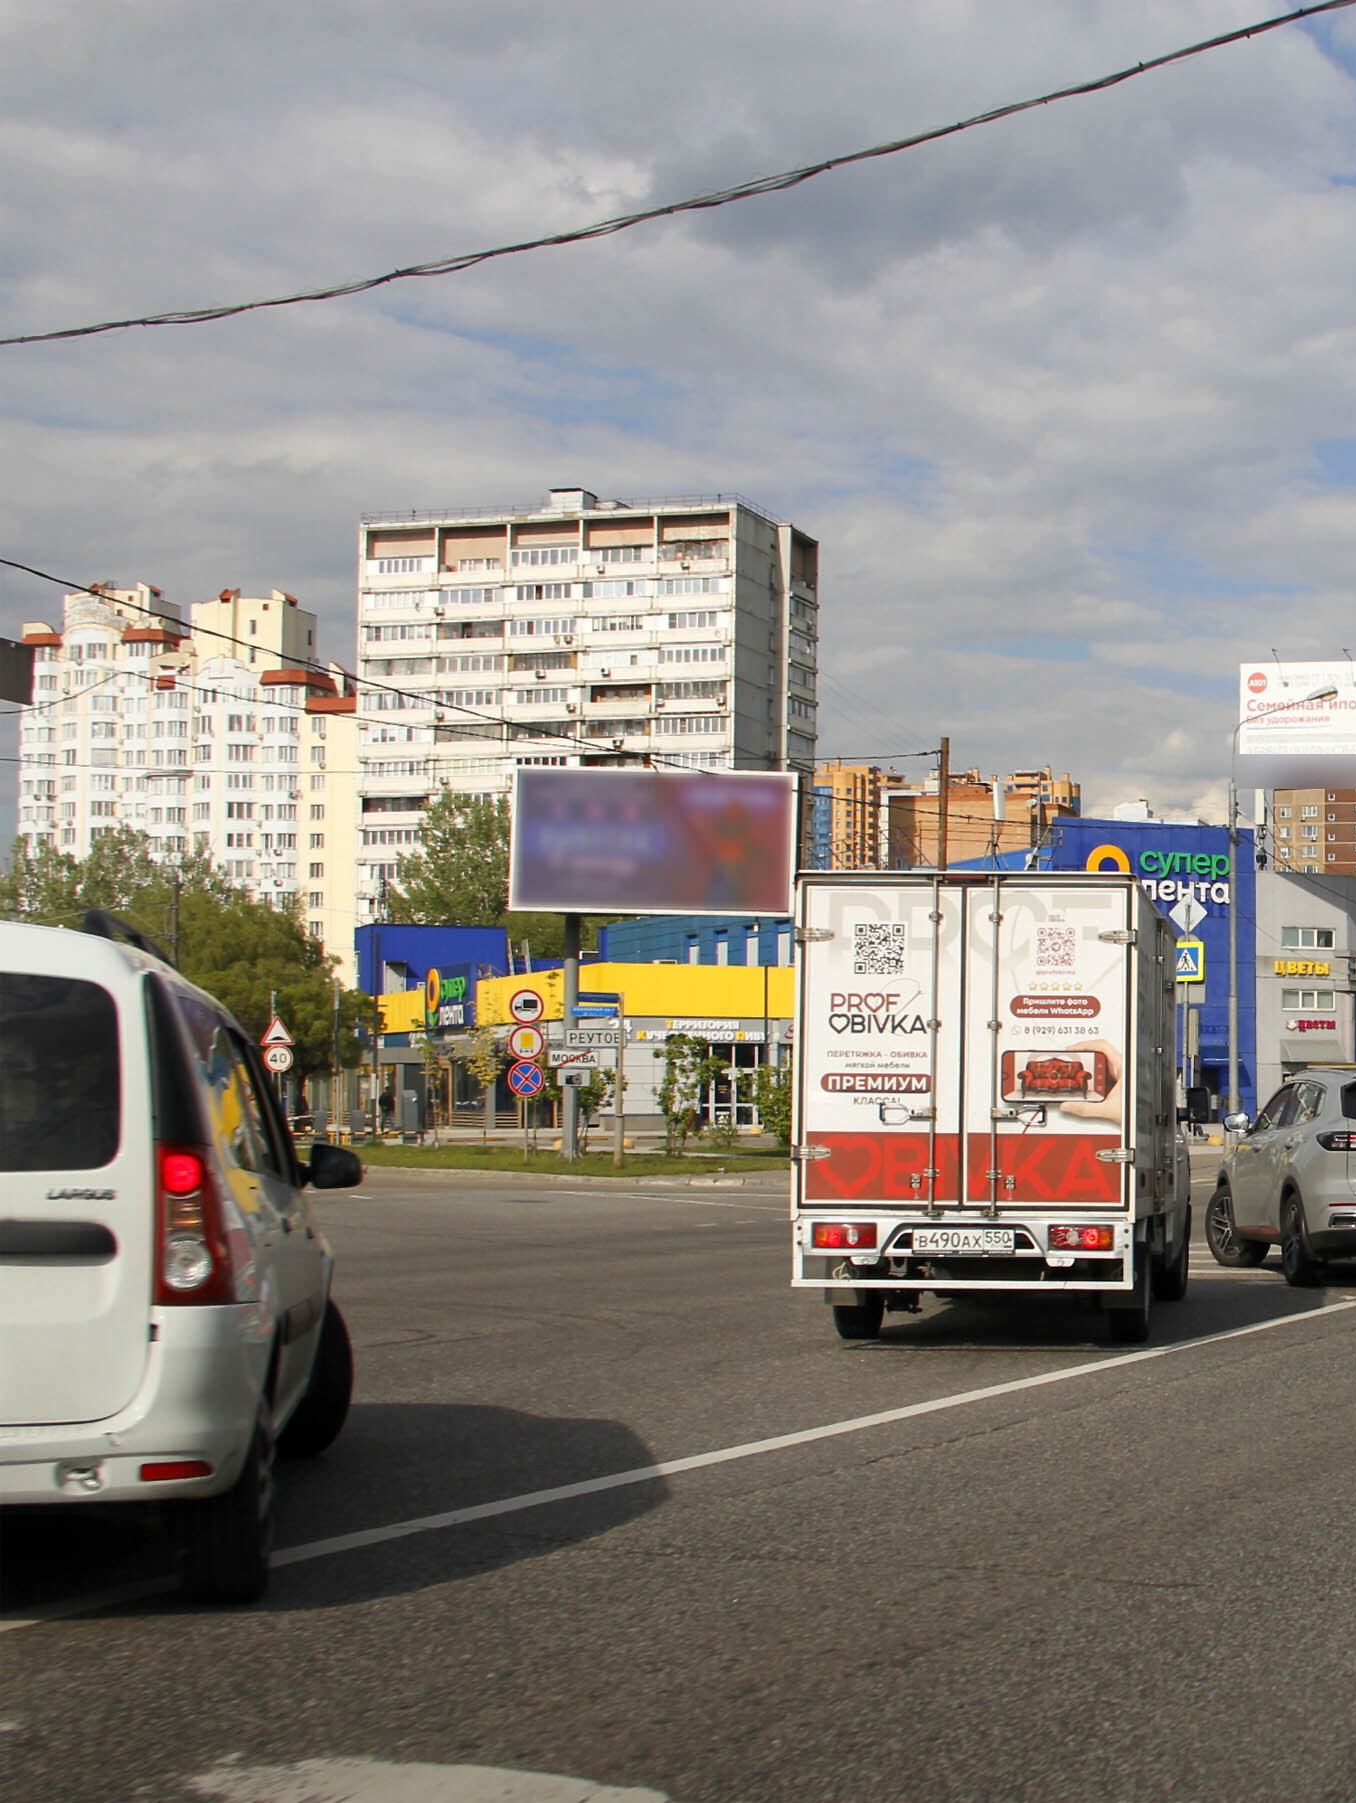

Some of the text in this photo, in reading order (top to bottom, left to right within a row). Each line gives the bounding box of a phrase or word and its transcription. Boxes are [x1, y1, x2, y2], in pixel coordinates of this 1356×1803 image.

[1247, 698, 1323, 711] Семейная
[1140, 850, 1231, 880] супер
[1141, 879, 1230, 904] лента
[1274, 960, 1331, 976] ЦВЕТЫ
[1023, 997, 1088, 1006] Пришлите фото
[1050, 1007, 1095, 1017] WhatsApp
[665, 1019, 740, 1030] ТЕРРИТОРИЯ
[1024, 1026, 1030, 1034] 8
[1033, 1025, 1056, 1035] (929)
[269, 1053, 287, 1063] 40
[552, 1054, 596, 1064] МОСКВА
[827, 1050, 882, 1058] ПЕРЕТЯЖКА
[890, 1050, 928, 1058] ОБИВКА
[845, 1060, 910, 1069] мягкой мебели
[828, 1075, 927, 1091] ПРЕМИУМ
[985, 1231, 1011, 1244] 550
